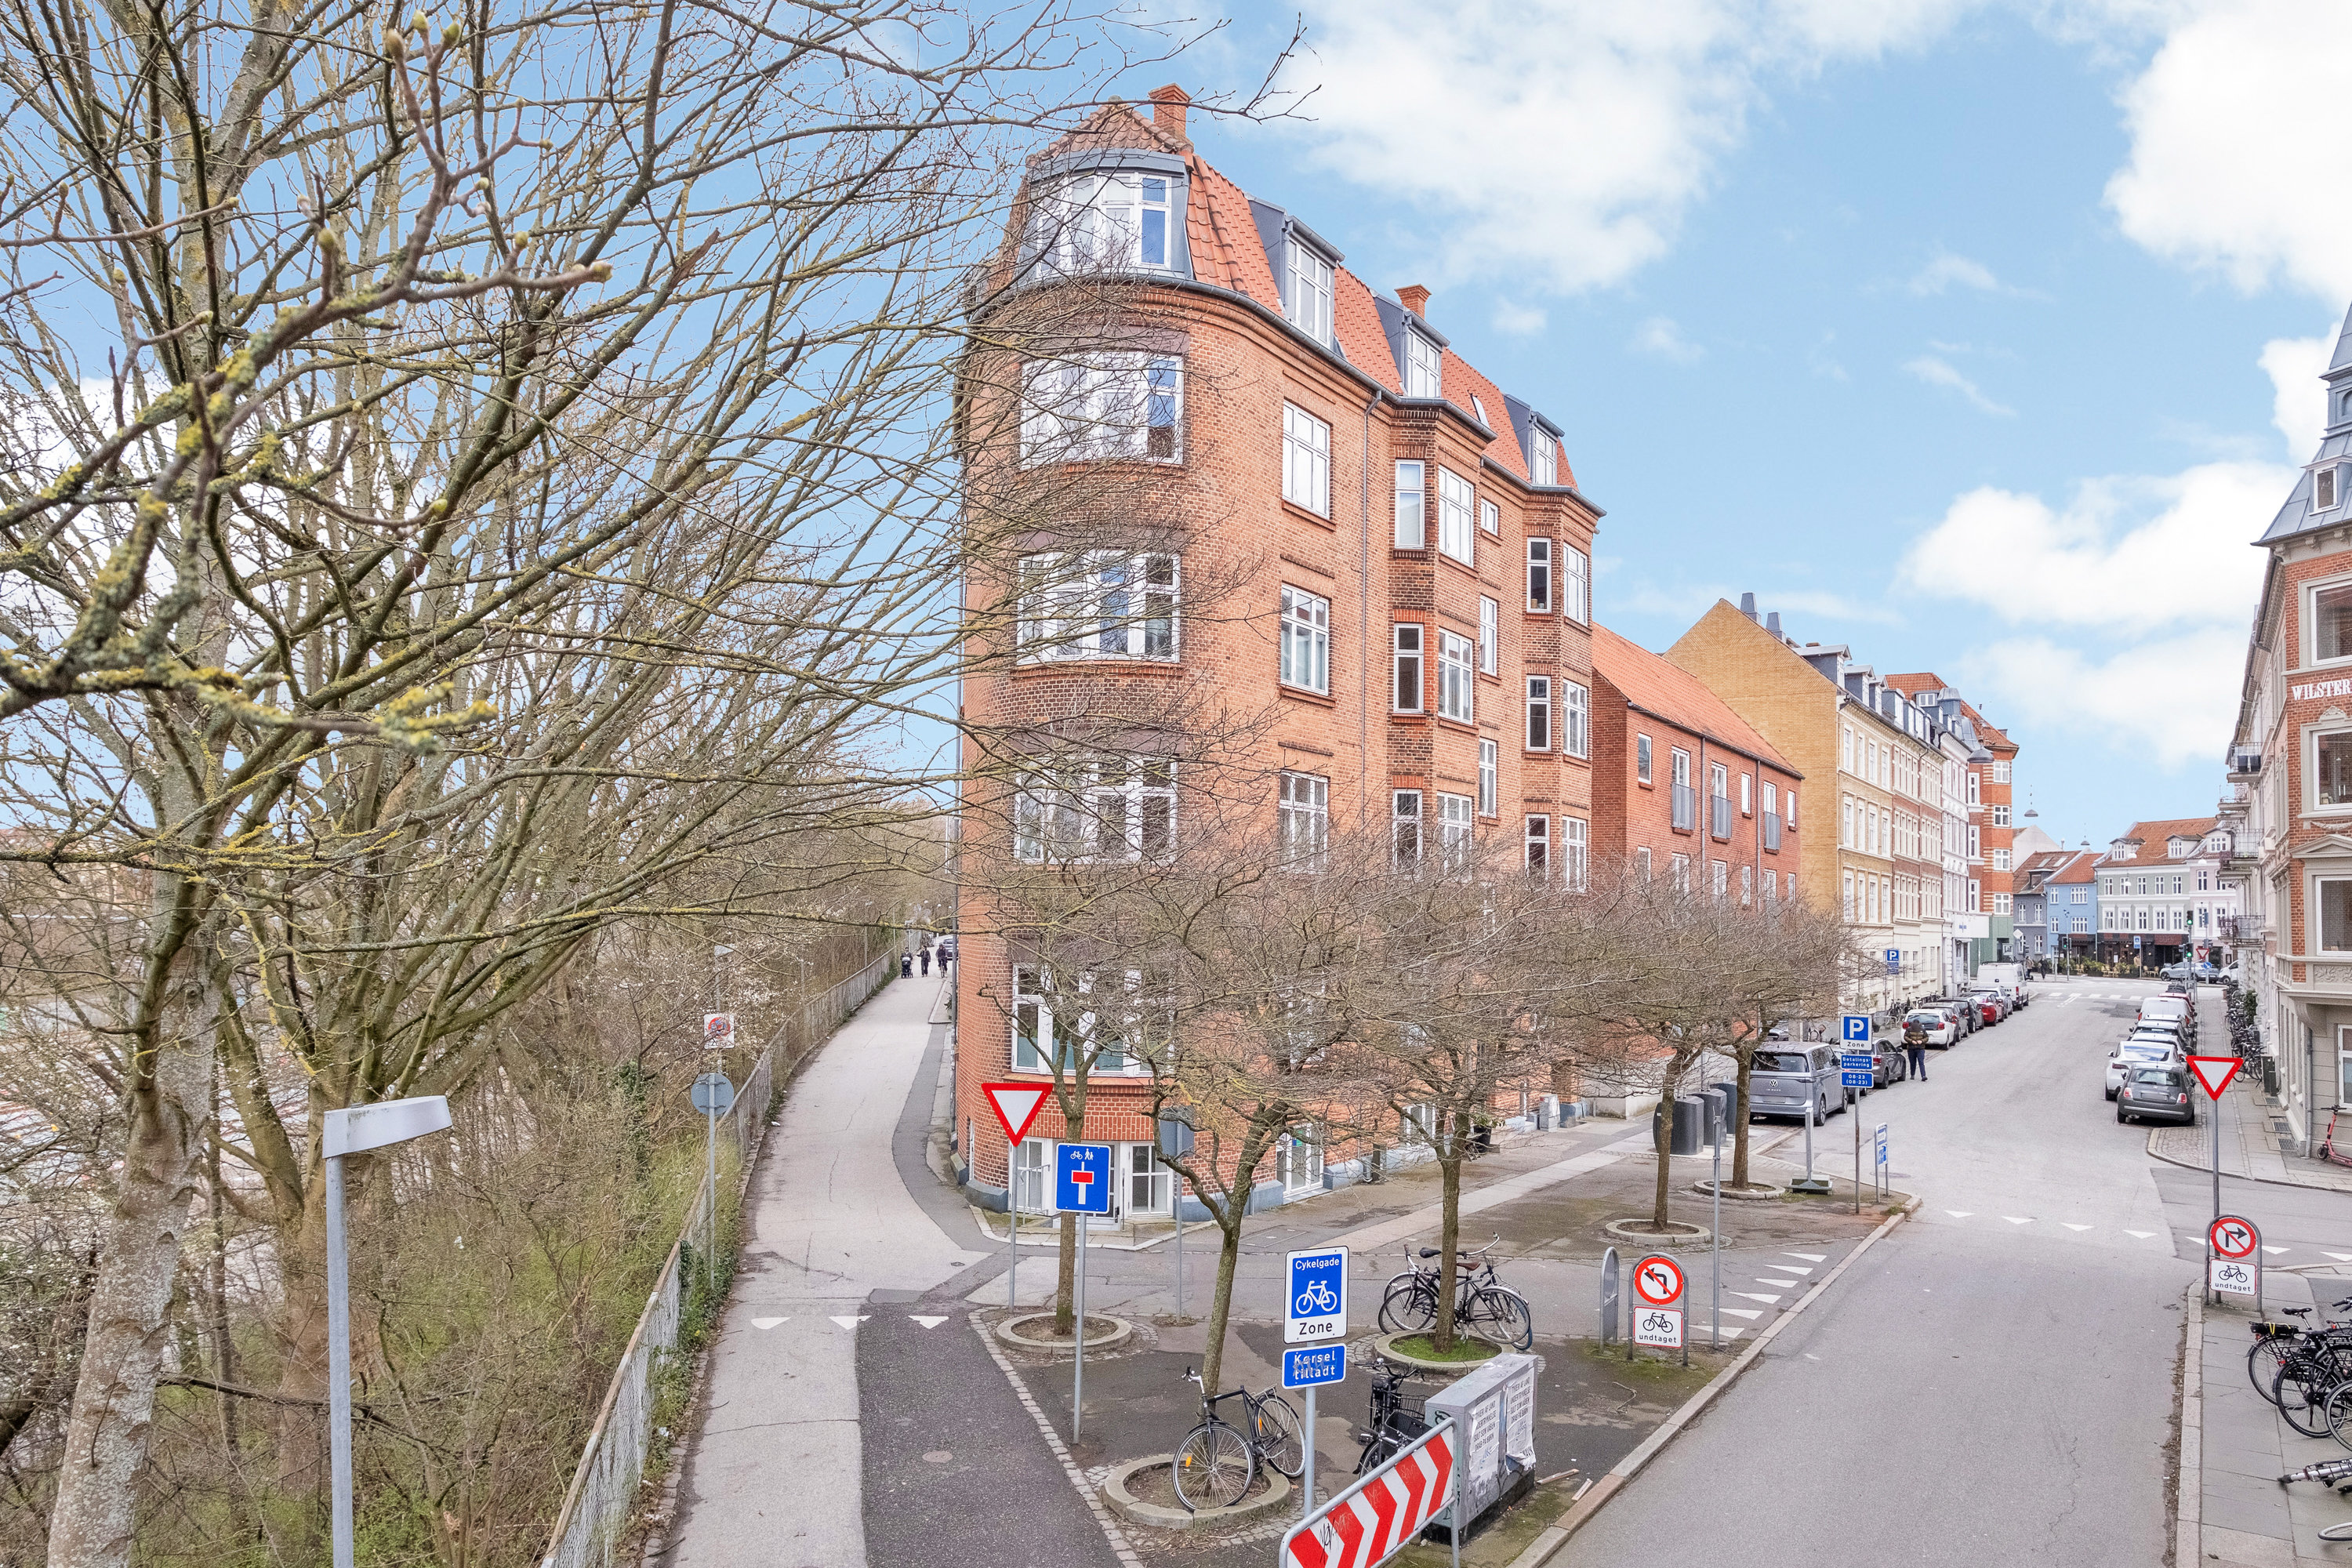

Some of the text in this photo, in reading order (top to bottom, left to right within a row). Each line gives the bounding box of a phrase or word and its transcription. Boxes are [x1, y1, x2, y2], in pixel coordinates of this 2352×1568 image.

[2291, 678, 2352, 701] WILSTER
[1889, 951, 1897, 960] P
[1849, 1019, 1864, 1038] P
[1295, 1257, 1340, 1271] Cykelgade
[2215, 1283, 2251, 1291] undtaget
[1299, 1323, 1333, 1335] Zone
[1639, 1334, 1676, 1343] undtaget
[1294, 1350, 1335, 1364] Kørsel
[1294, 1365, 1335, 1380] tilladt
